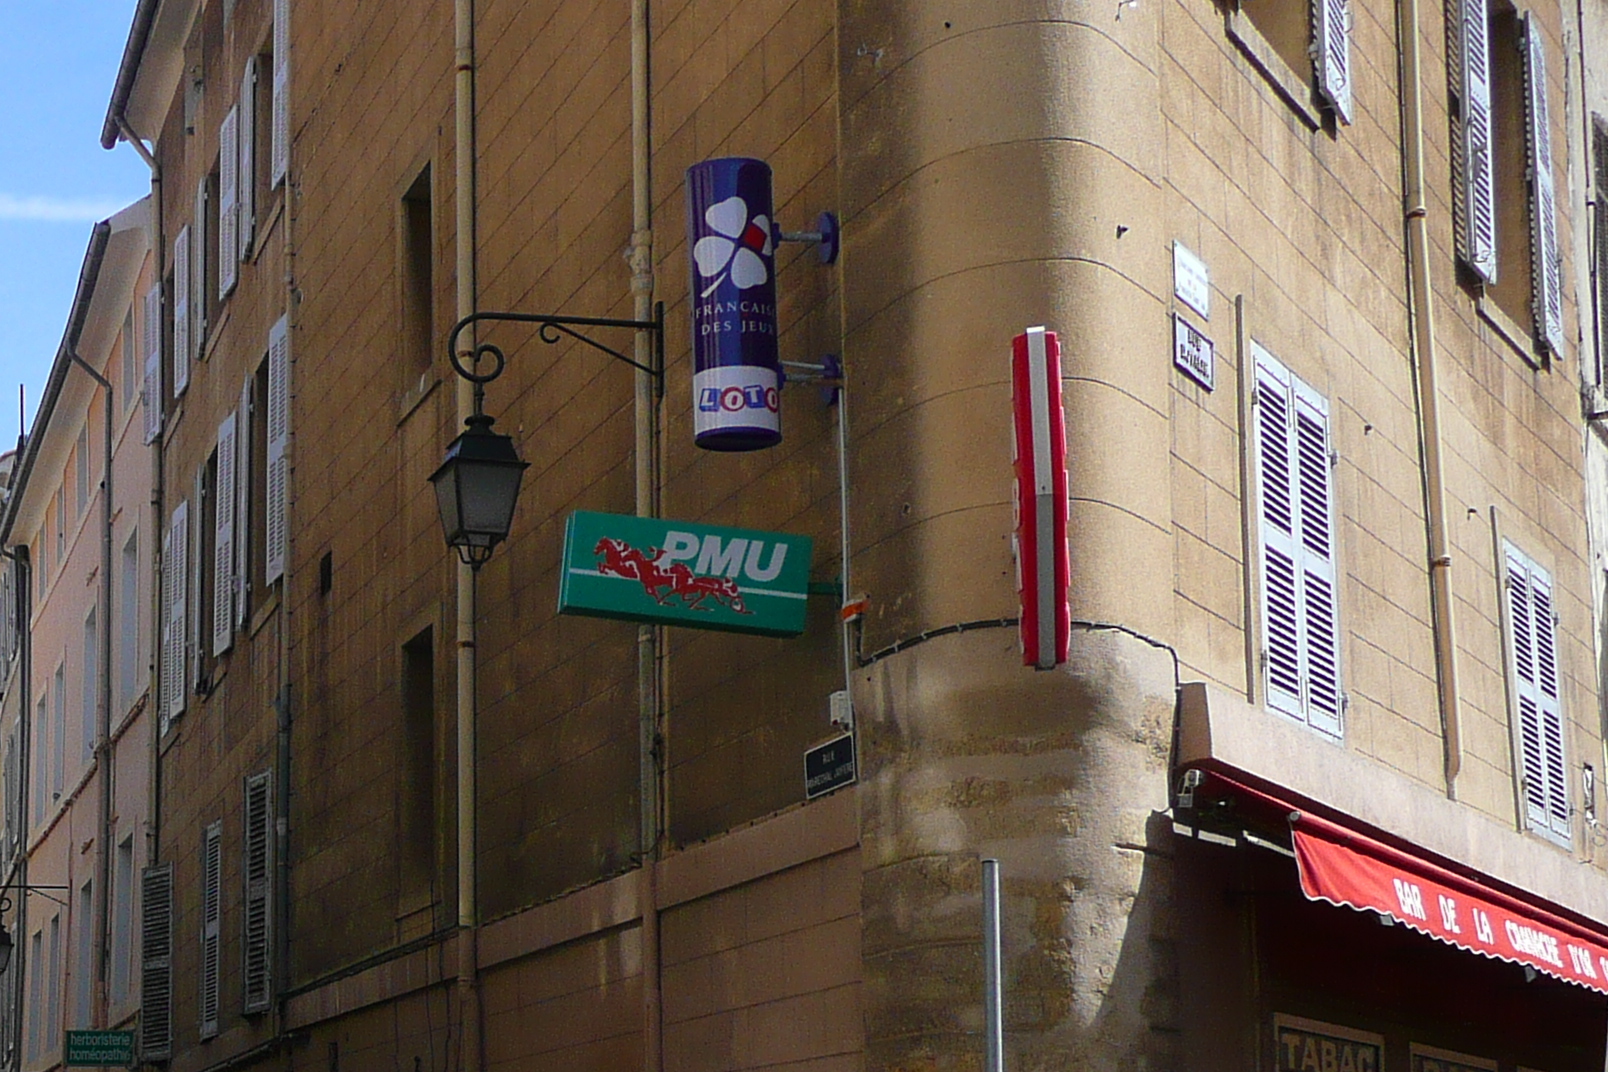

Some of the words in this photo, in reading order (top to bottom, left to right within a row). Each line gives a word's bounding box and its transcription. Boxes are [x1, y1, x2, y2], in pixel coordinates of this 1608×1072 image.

[701, 321, 732, 336] DES
[699, 385, 779, 413] LOTO
[661, 531, 789, 583] PMU
[1393, 878, 1426, 921] BAR
[1439, 894, 1461, 934] DE
[1472, 908, 1494, 945] LA
[70, 1032, 130, 1046] herboristerie
